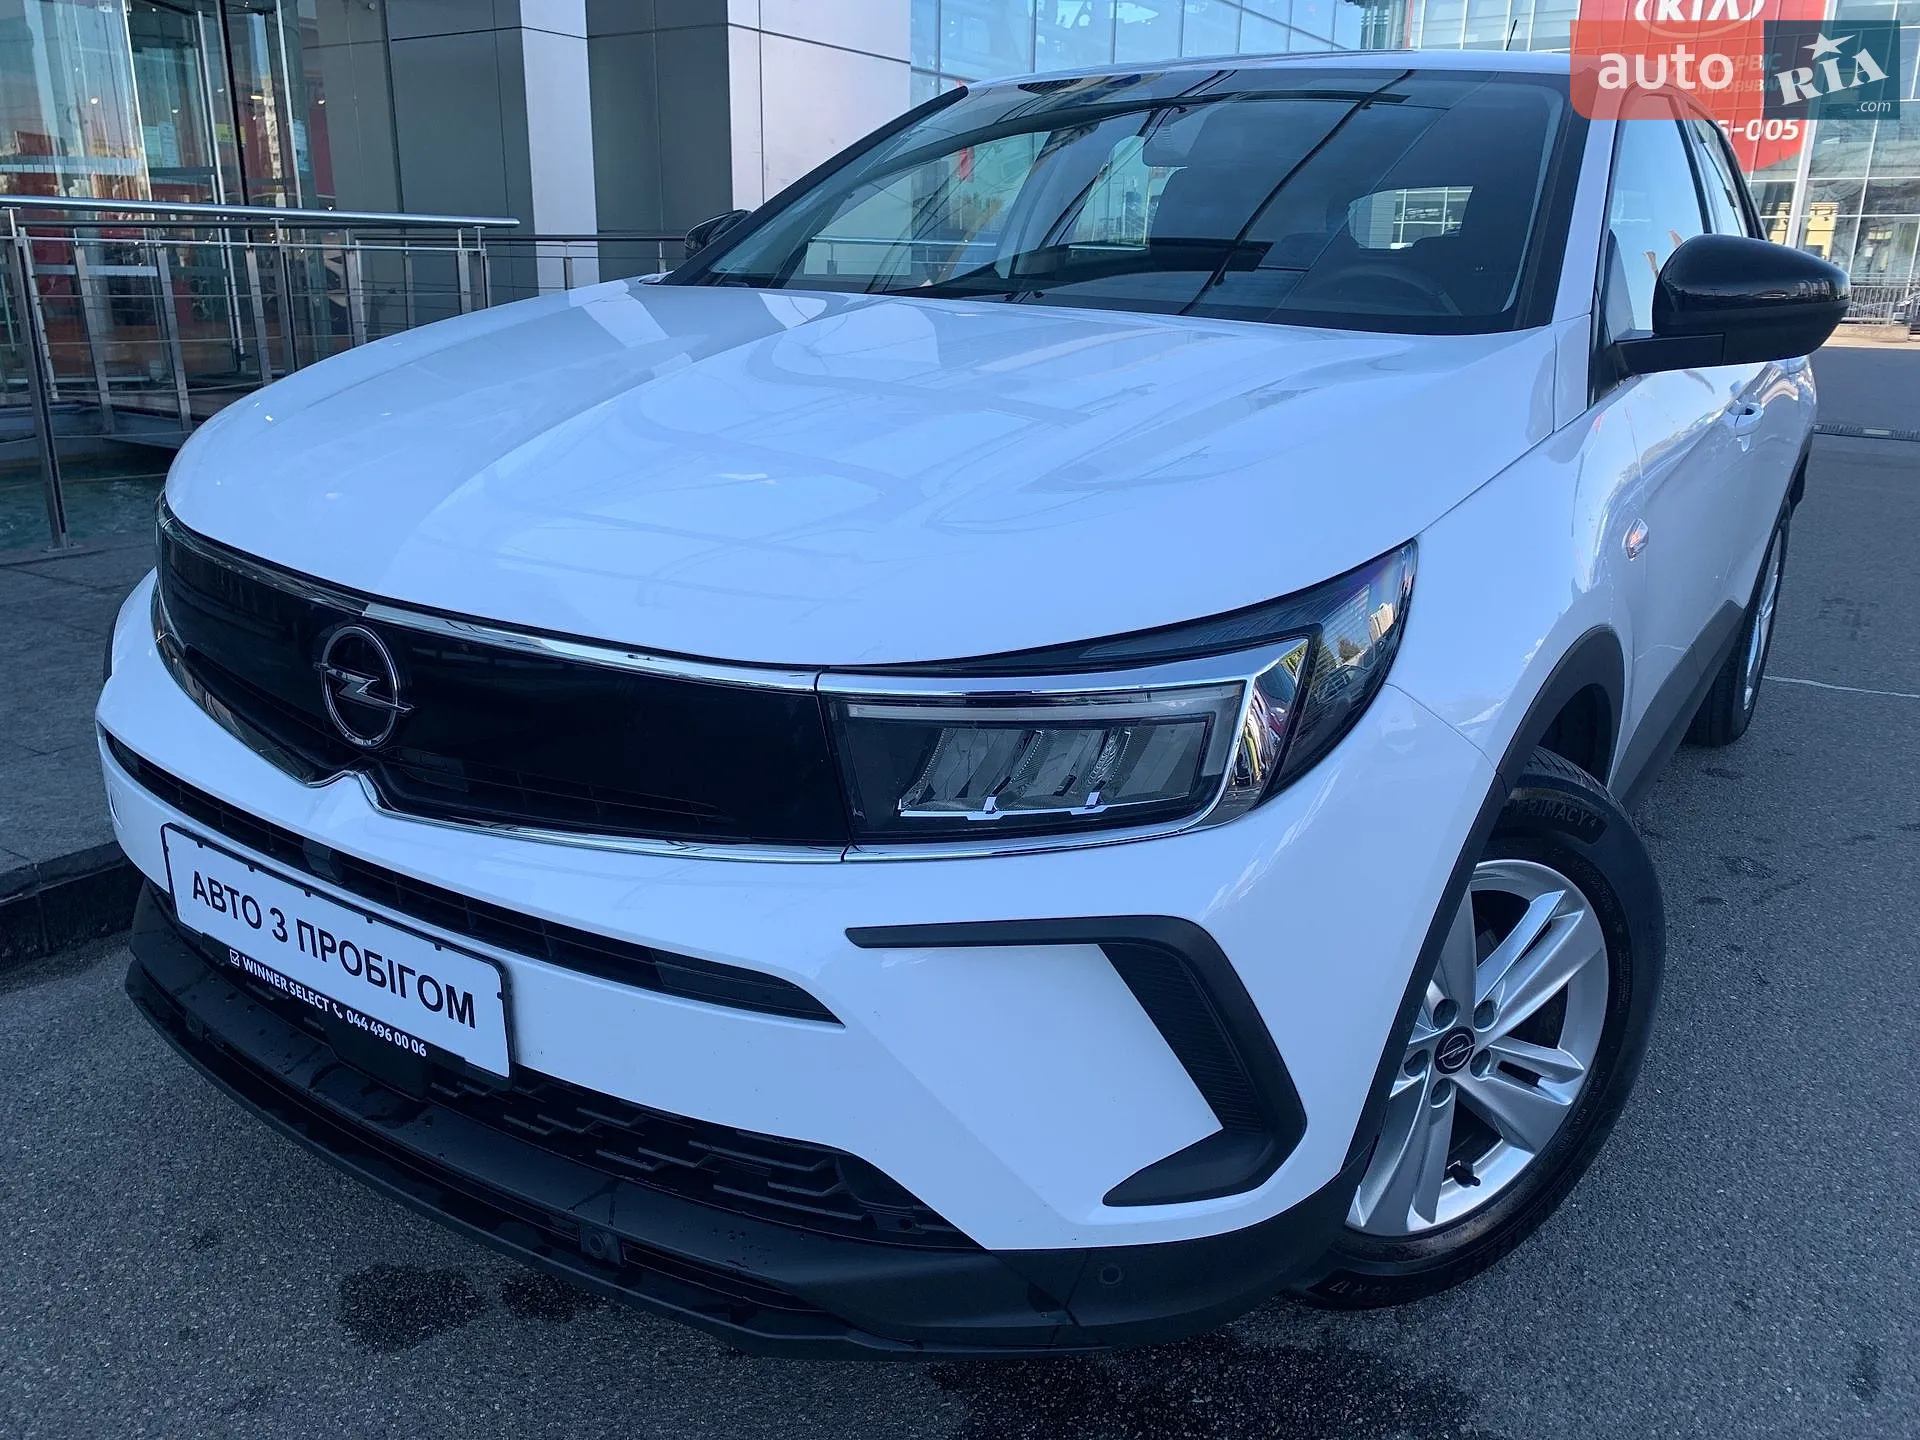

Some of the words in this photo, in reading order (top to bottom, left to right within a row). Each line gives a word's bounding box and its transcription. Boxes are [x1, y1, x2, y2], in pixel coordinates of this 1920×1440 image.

[192, 870, 262, 929] АВТО
[296, 918, 476, 1029] ПРОБІГОМ
[242, 956, 289, 992] WINNER
[289, 981, 329, 1012] SELECT
[346, 1009, 369, 1031] 044
[370, 1021, 393, 1042] 496
[394, 1032, 409, 1049] 00
[411, 1039, 427, 1057] 06
